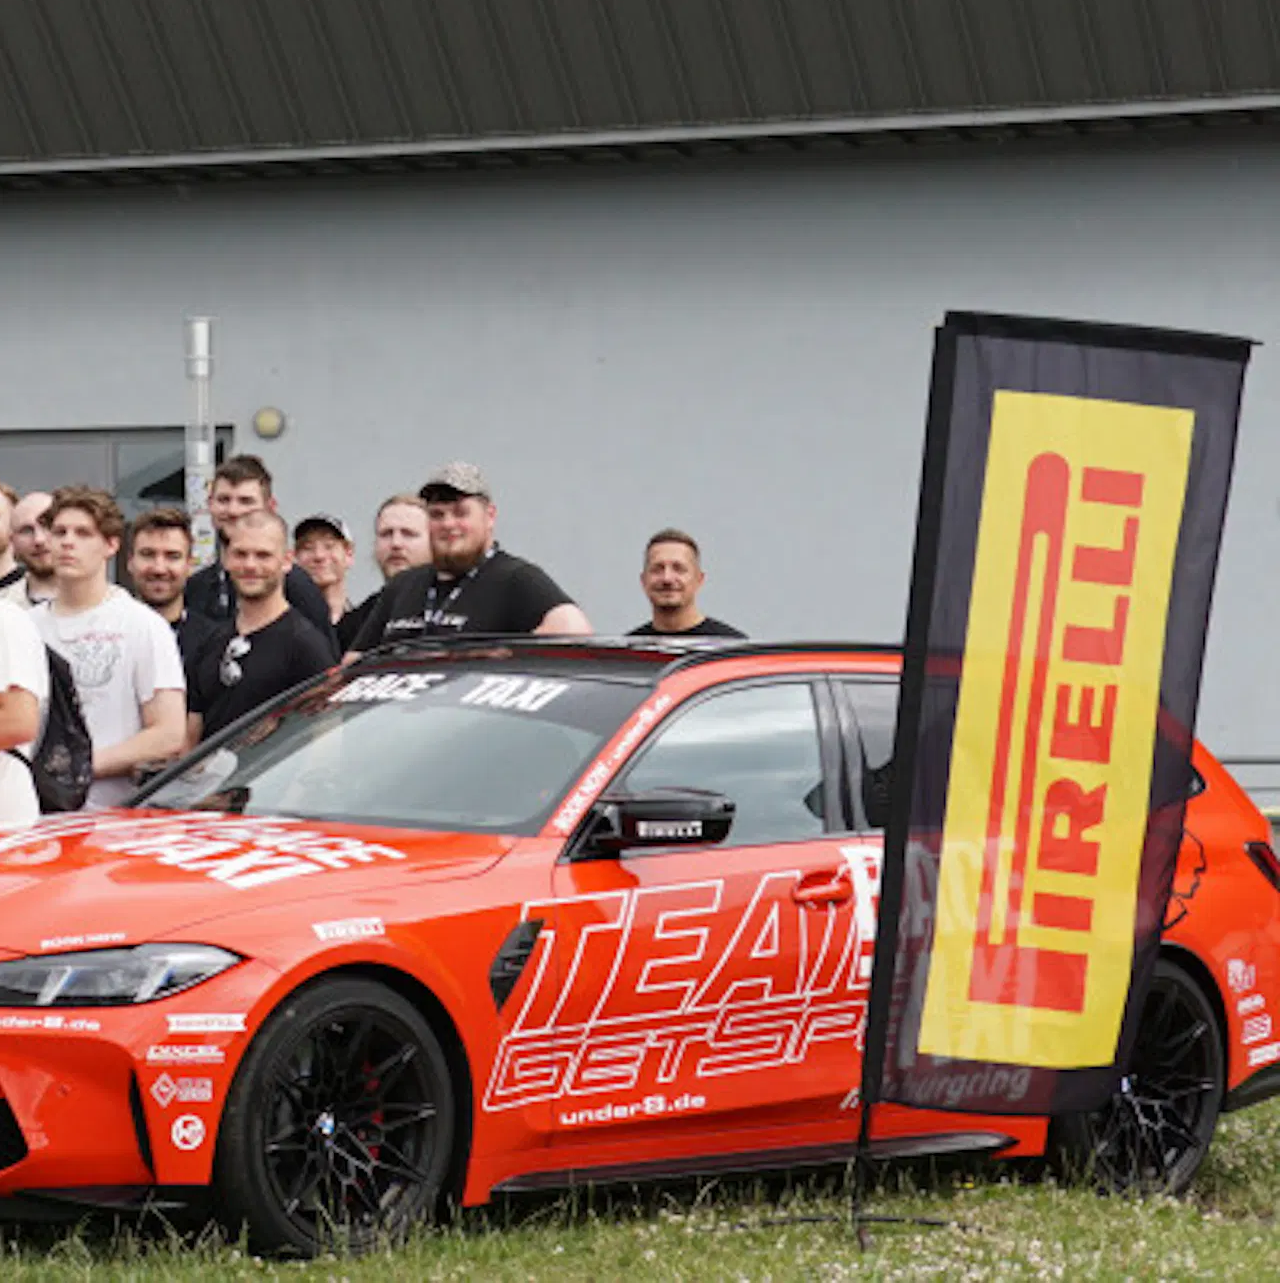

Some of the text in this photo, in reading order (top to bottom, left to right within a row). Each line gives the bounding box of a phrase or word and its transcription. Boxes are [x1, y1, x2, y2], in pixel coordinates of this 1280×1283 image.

[328, 673, 571, 712] RACE TAXI
[967, 451, 1146, 1015] PIRELLI
[560, 1093, 707, 1126] under8.de
